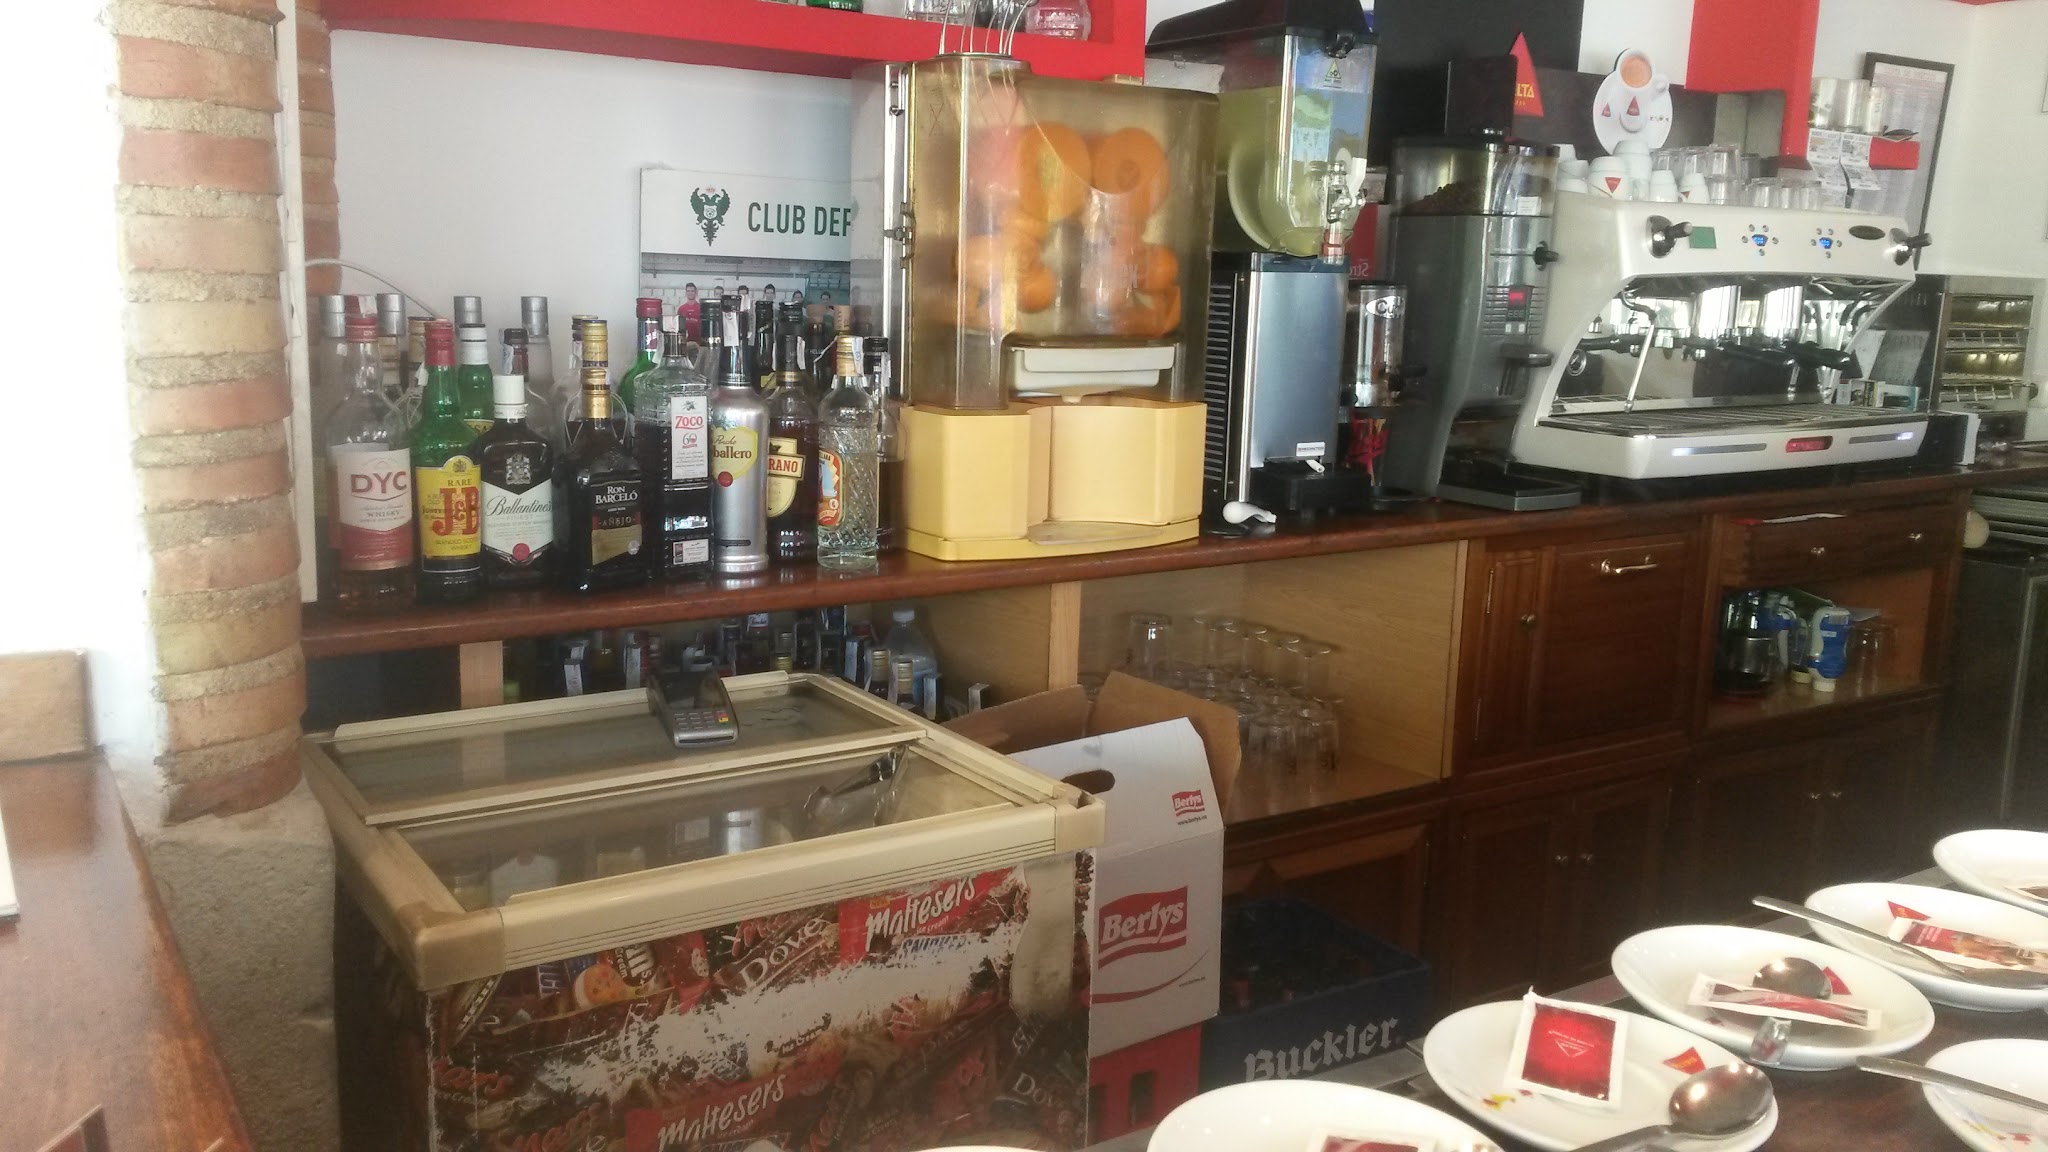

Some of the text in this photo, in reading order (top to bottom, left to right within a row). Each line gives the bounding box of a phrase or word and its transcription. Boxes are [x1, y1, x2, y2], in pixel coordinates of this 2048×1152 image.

[1515, 83, 1535, 98] LTA
[748, 201, 806, 235] CLUB
[350, 470, 408, 494] DYC
[447, 478, 473, 487] RARE
[607, 485, 626, 495] RON
[595, 490, 638, 505] BARCELÓ
[865, 875, 976, 952] Maltesers
[1101, 902, 1185, 945] Berlys
[739, 915, 824, 988] Dove
[1244, 1017, 1399, 1083] Buckler
